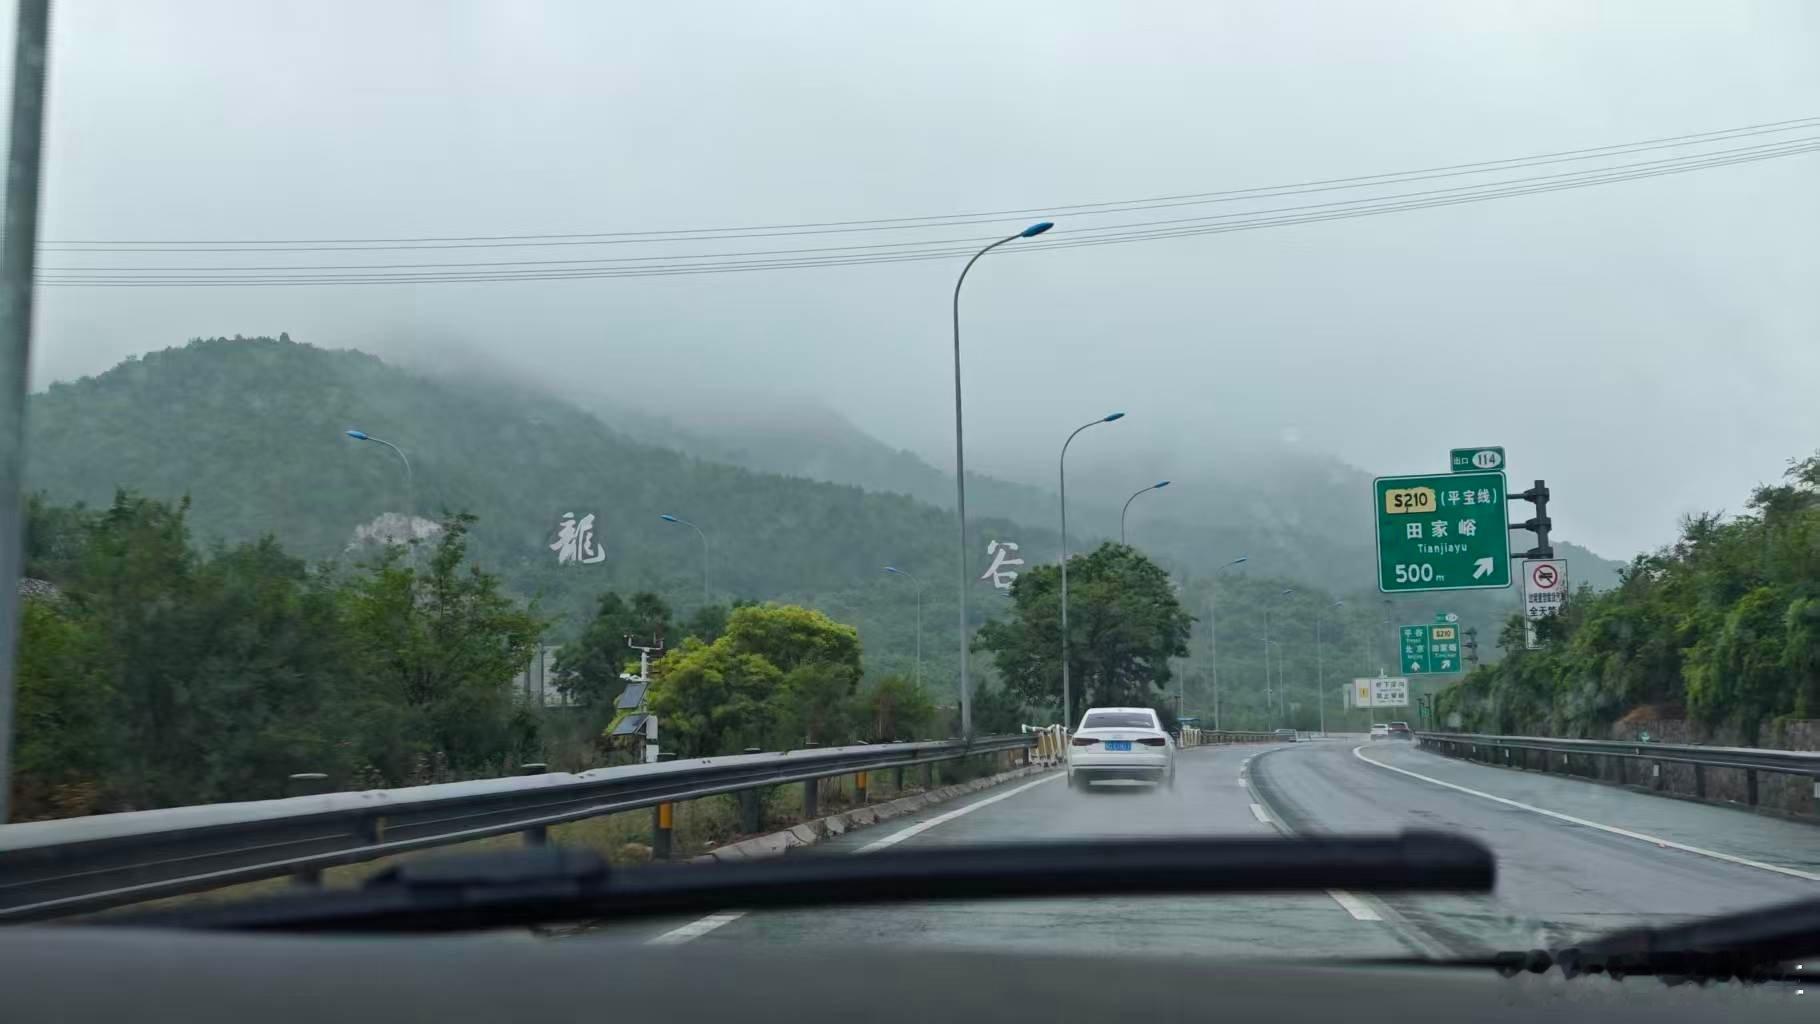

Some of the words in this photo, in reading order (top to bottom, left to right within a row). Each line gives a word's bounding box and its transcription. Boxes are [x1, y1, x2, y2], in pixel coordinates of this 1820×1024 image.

[1477, 454, 1496, 465] 114
[1394, 492, 1428, 508] S210
[1406, 518, 1477, 539] 田家峪
[1417, 543, 1468, 555] Tianjiayu
[980, 539, 1025, 589] 谷
